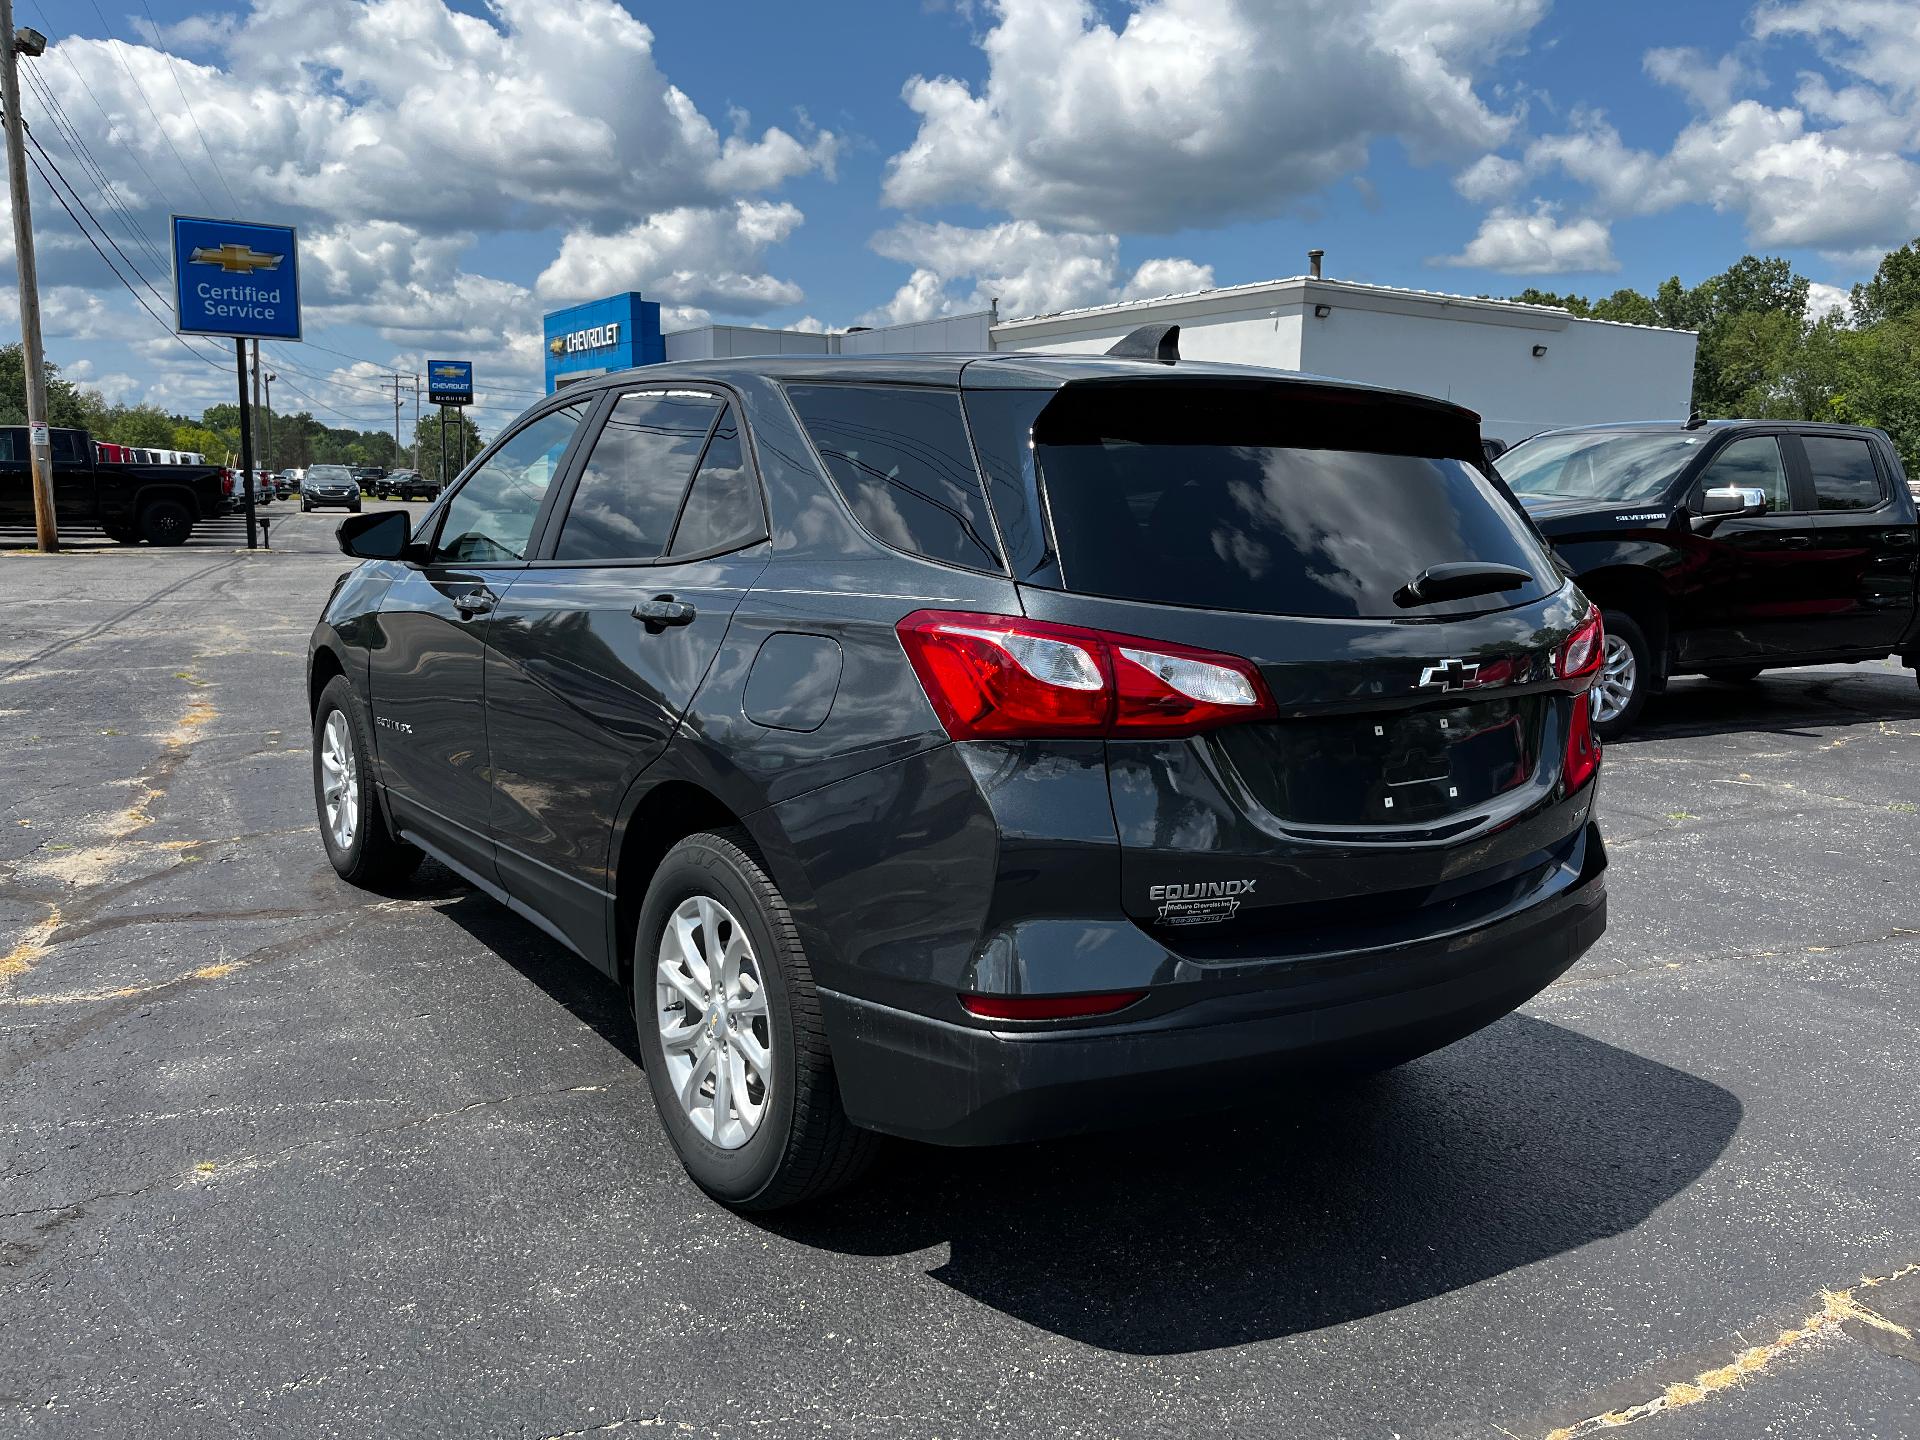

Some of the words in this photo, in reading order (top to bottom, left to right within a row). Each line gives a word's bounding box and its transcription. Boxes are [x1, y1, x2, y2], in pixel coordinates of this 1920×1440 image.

[197, 283, 280, 303] Certified
[204, 300, 275, 320] Service
[566, 323, 618, 352] CHEVROLET
[431, 382, 470, 390] CHEVROLET
[1615, 513, 1667, 521] SILVERADO
[1149, 880, 1257, 900] EQUINOX
